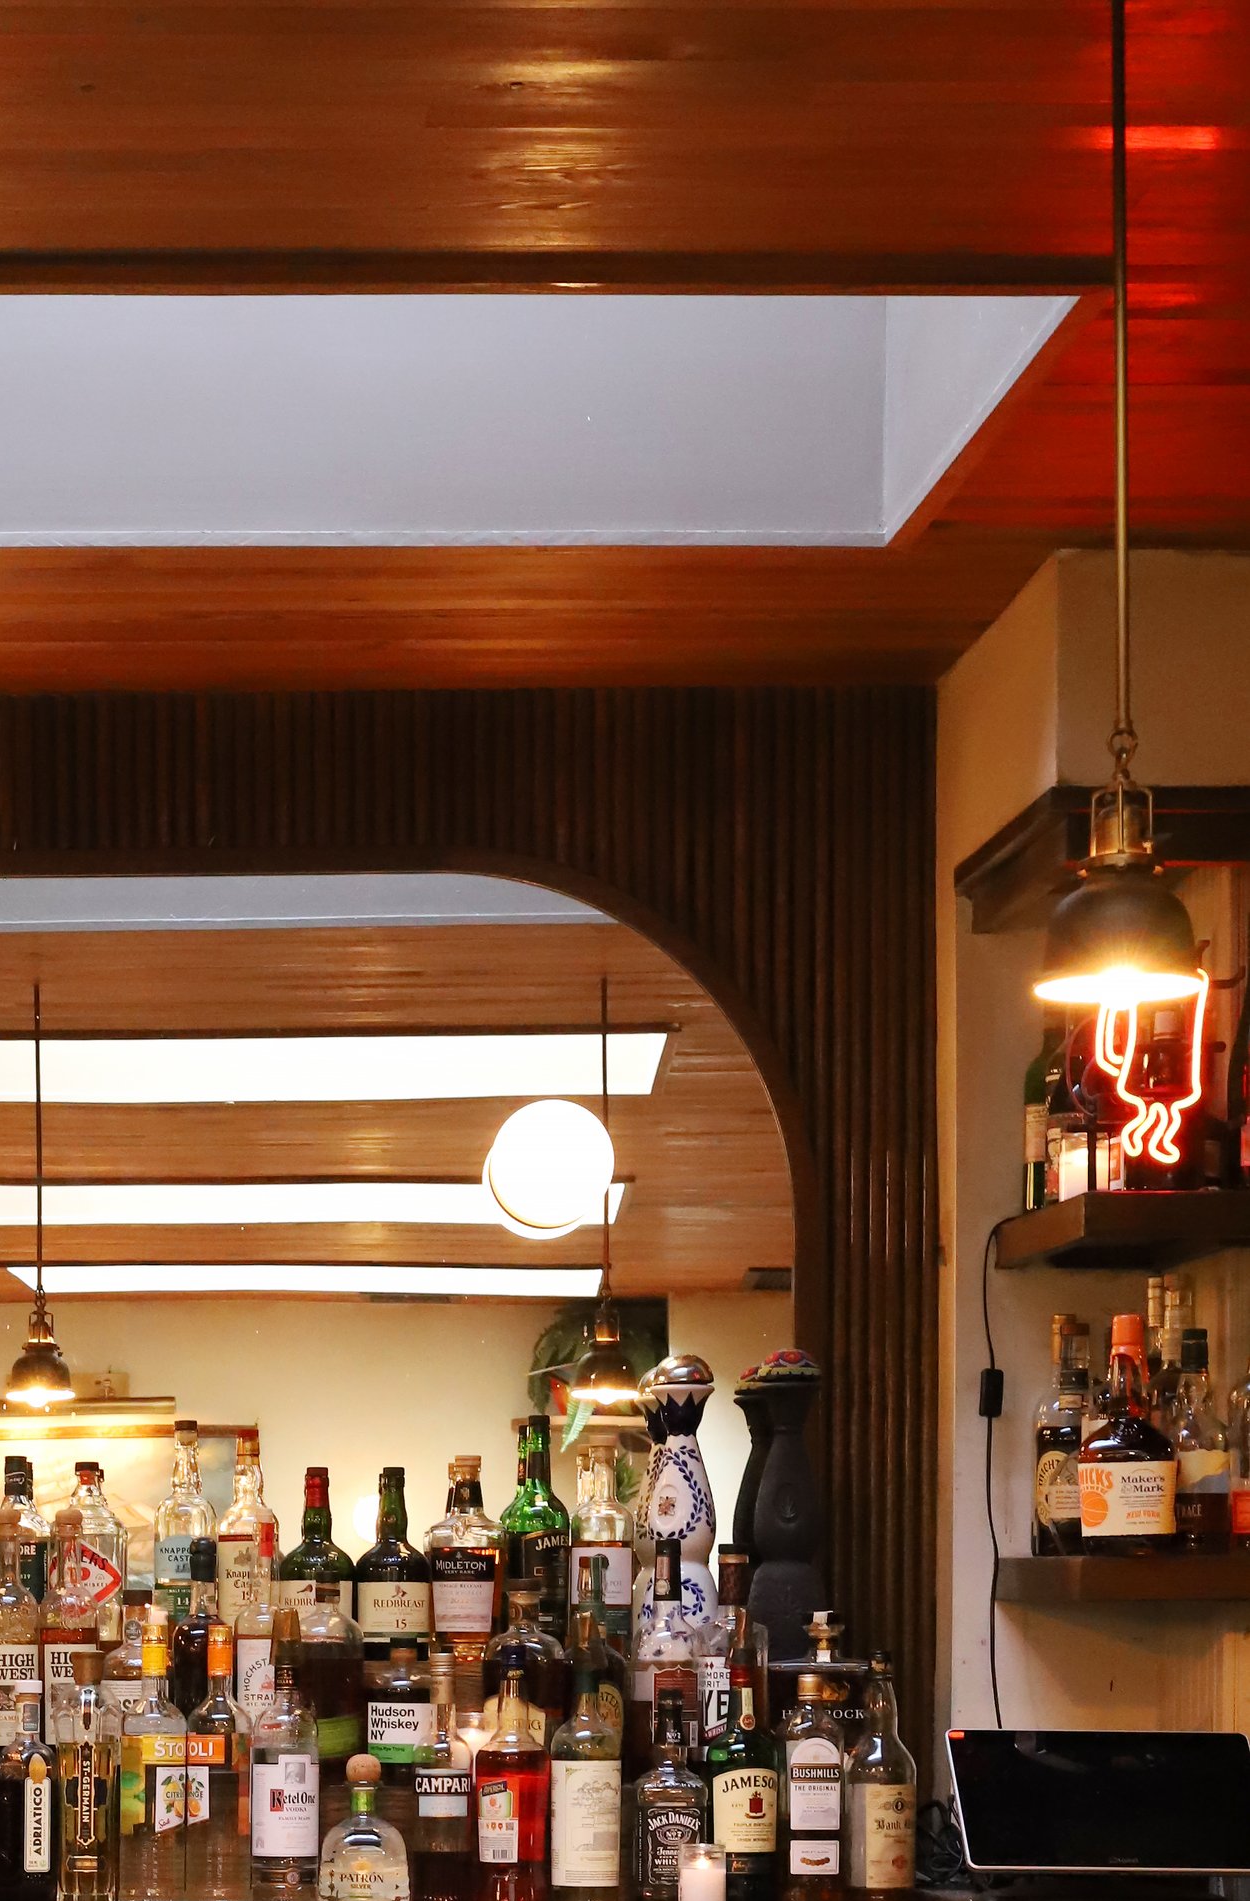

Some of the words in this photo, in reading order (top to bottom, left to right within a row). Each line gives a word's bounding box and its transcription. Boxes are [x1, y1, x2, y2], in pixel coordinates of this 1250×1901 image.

[1121, 1475, 1165, 1484] Maker's
[1133, 1484, 1165, 1493] Mark
[535, 1535, 569, 1551] JAMES
[167, 1554, 190, 1562] CAST
[435, 1560, 486, 1572] MIDLETON
[373, 1598, 426, 1608] REDBREAST
[395, 1618, 407, 1630] 15
[51, 1665, 73, 1678] WE
[244, 1693, 274, 1701] STRAI
[370, 1705, 415, 1717] Hudson
[370, 1717, 419, 1731] Whiskey
[370, 1729, 386, 1741] NY
[792, 1767, 840, 1778] BUSHMILLS
[415, 1776, 471, 1793] CAMPARI
[722, 1775, 775, 1793] JAMESO
[82, 1760, 91, 1823] ST-GERMAIN
[272, 1790, 300, 1808] Ketel
[300, 1791, 316, 1804] One
[32, 1786, 43, 1856] ADRIATICO
[647, 1814, 669, 1831] JACK
[654, 1858, 677, 1866] WHIS
[340, 1871, 384, 1883] PATRÓN
